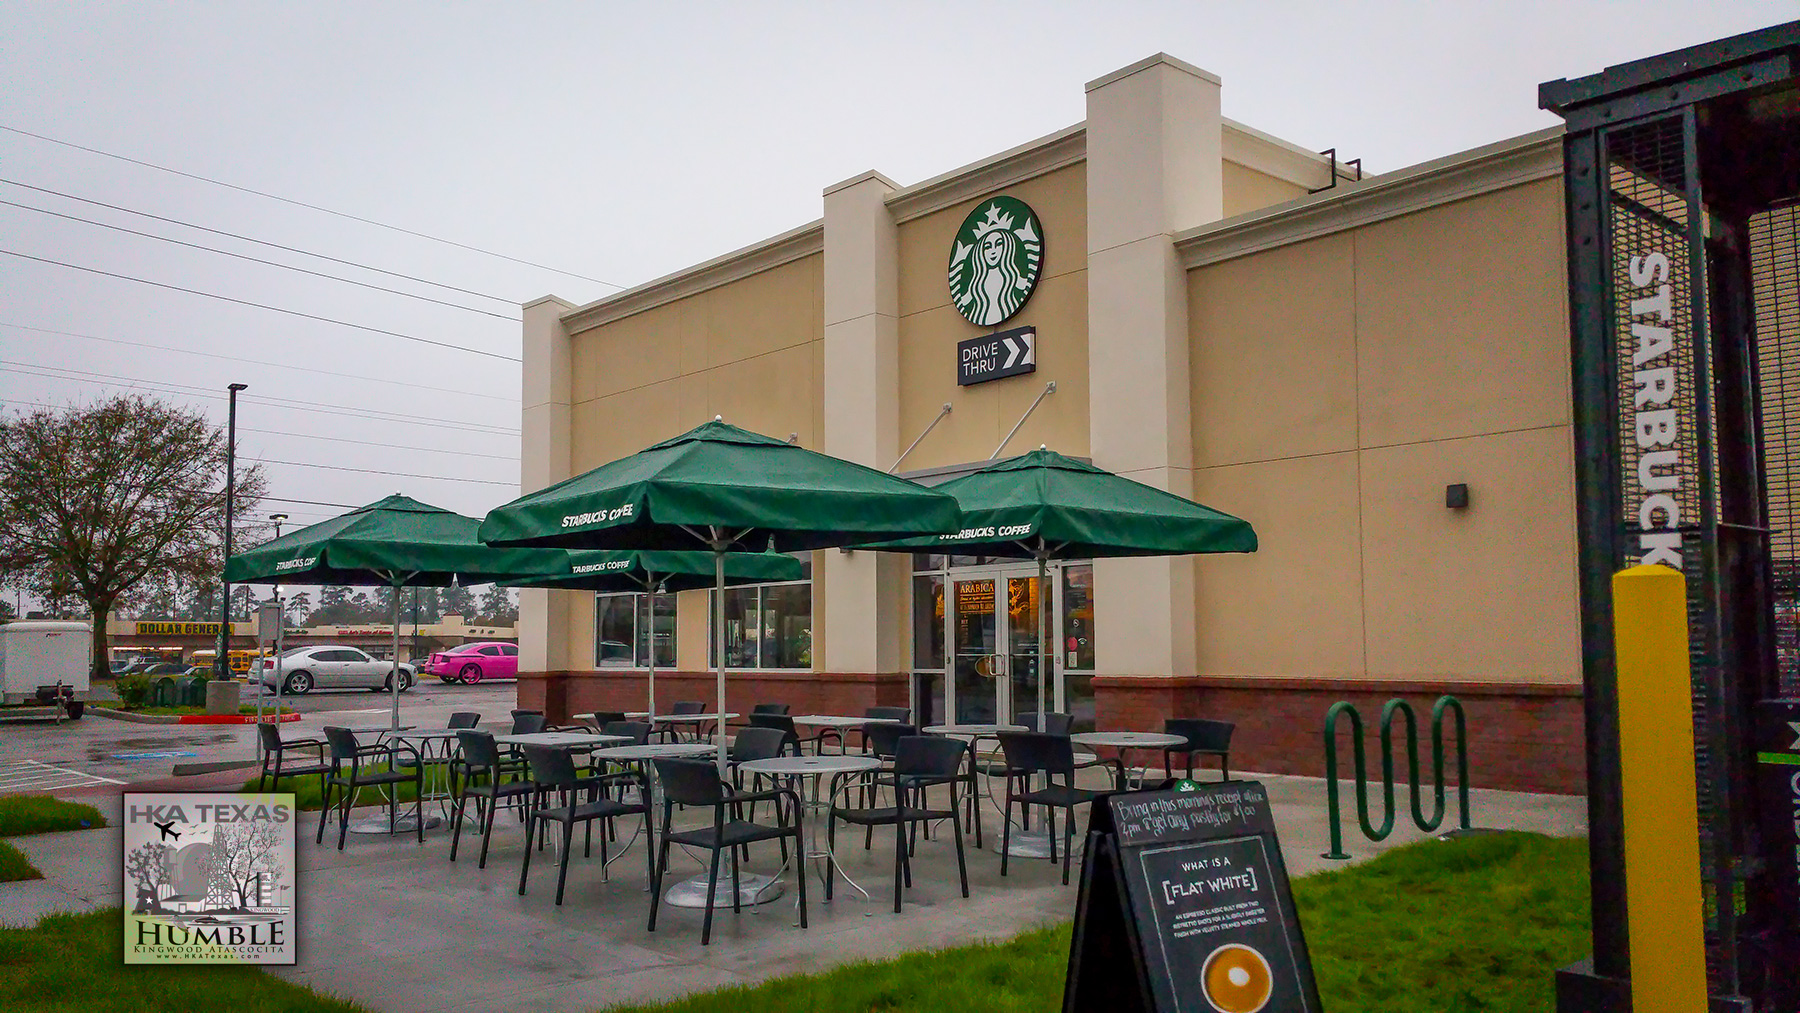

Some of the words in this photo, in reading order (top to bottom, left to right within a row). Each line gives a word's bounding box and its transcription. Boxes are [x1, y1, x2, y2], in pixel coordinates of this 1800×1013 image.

[962, 341, 998, 362] DRIVE
[963, 357, 996, 376] THRU
[1630, 252, 1682, 568] STARBUCK
[572, 562, 606, 574] TARBUCKS
[960, 583, 994, 594] ARABICA
[140, 623, 182, 635] DOLLAR
[184, 624, 234, 635] GENERL
[1117, 801, 1152, 821] Bring
[1150, 801, 1159, 812] in
[1158, 798, 1177, 813] this
[1167, 814, 1190, 832] any
[1181, 859, 1209, 872] WHAT
[1211, 857, 1222, 868] IS
[1223, 856, 1232, 867] A
